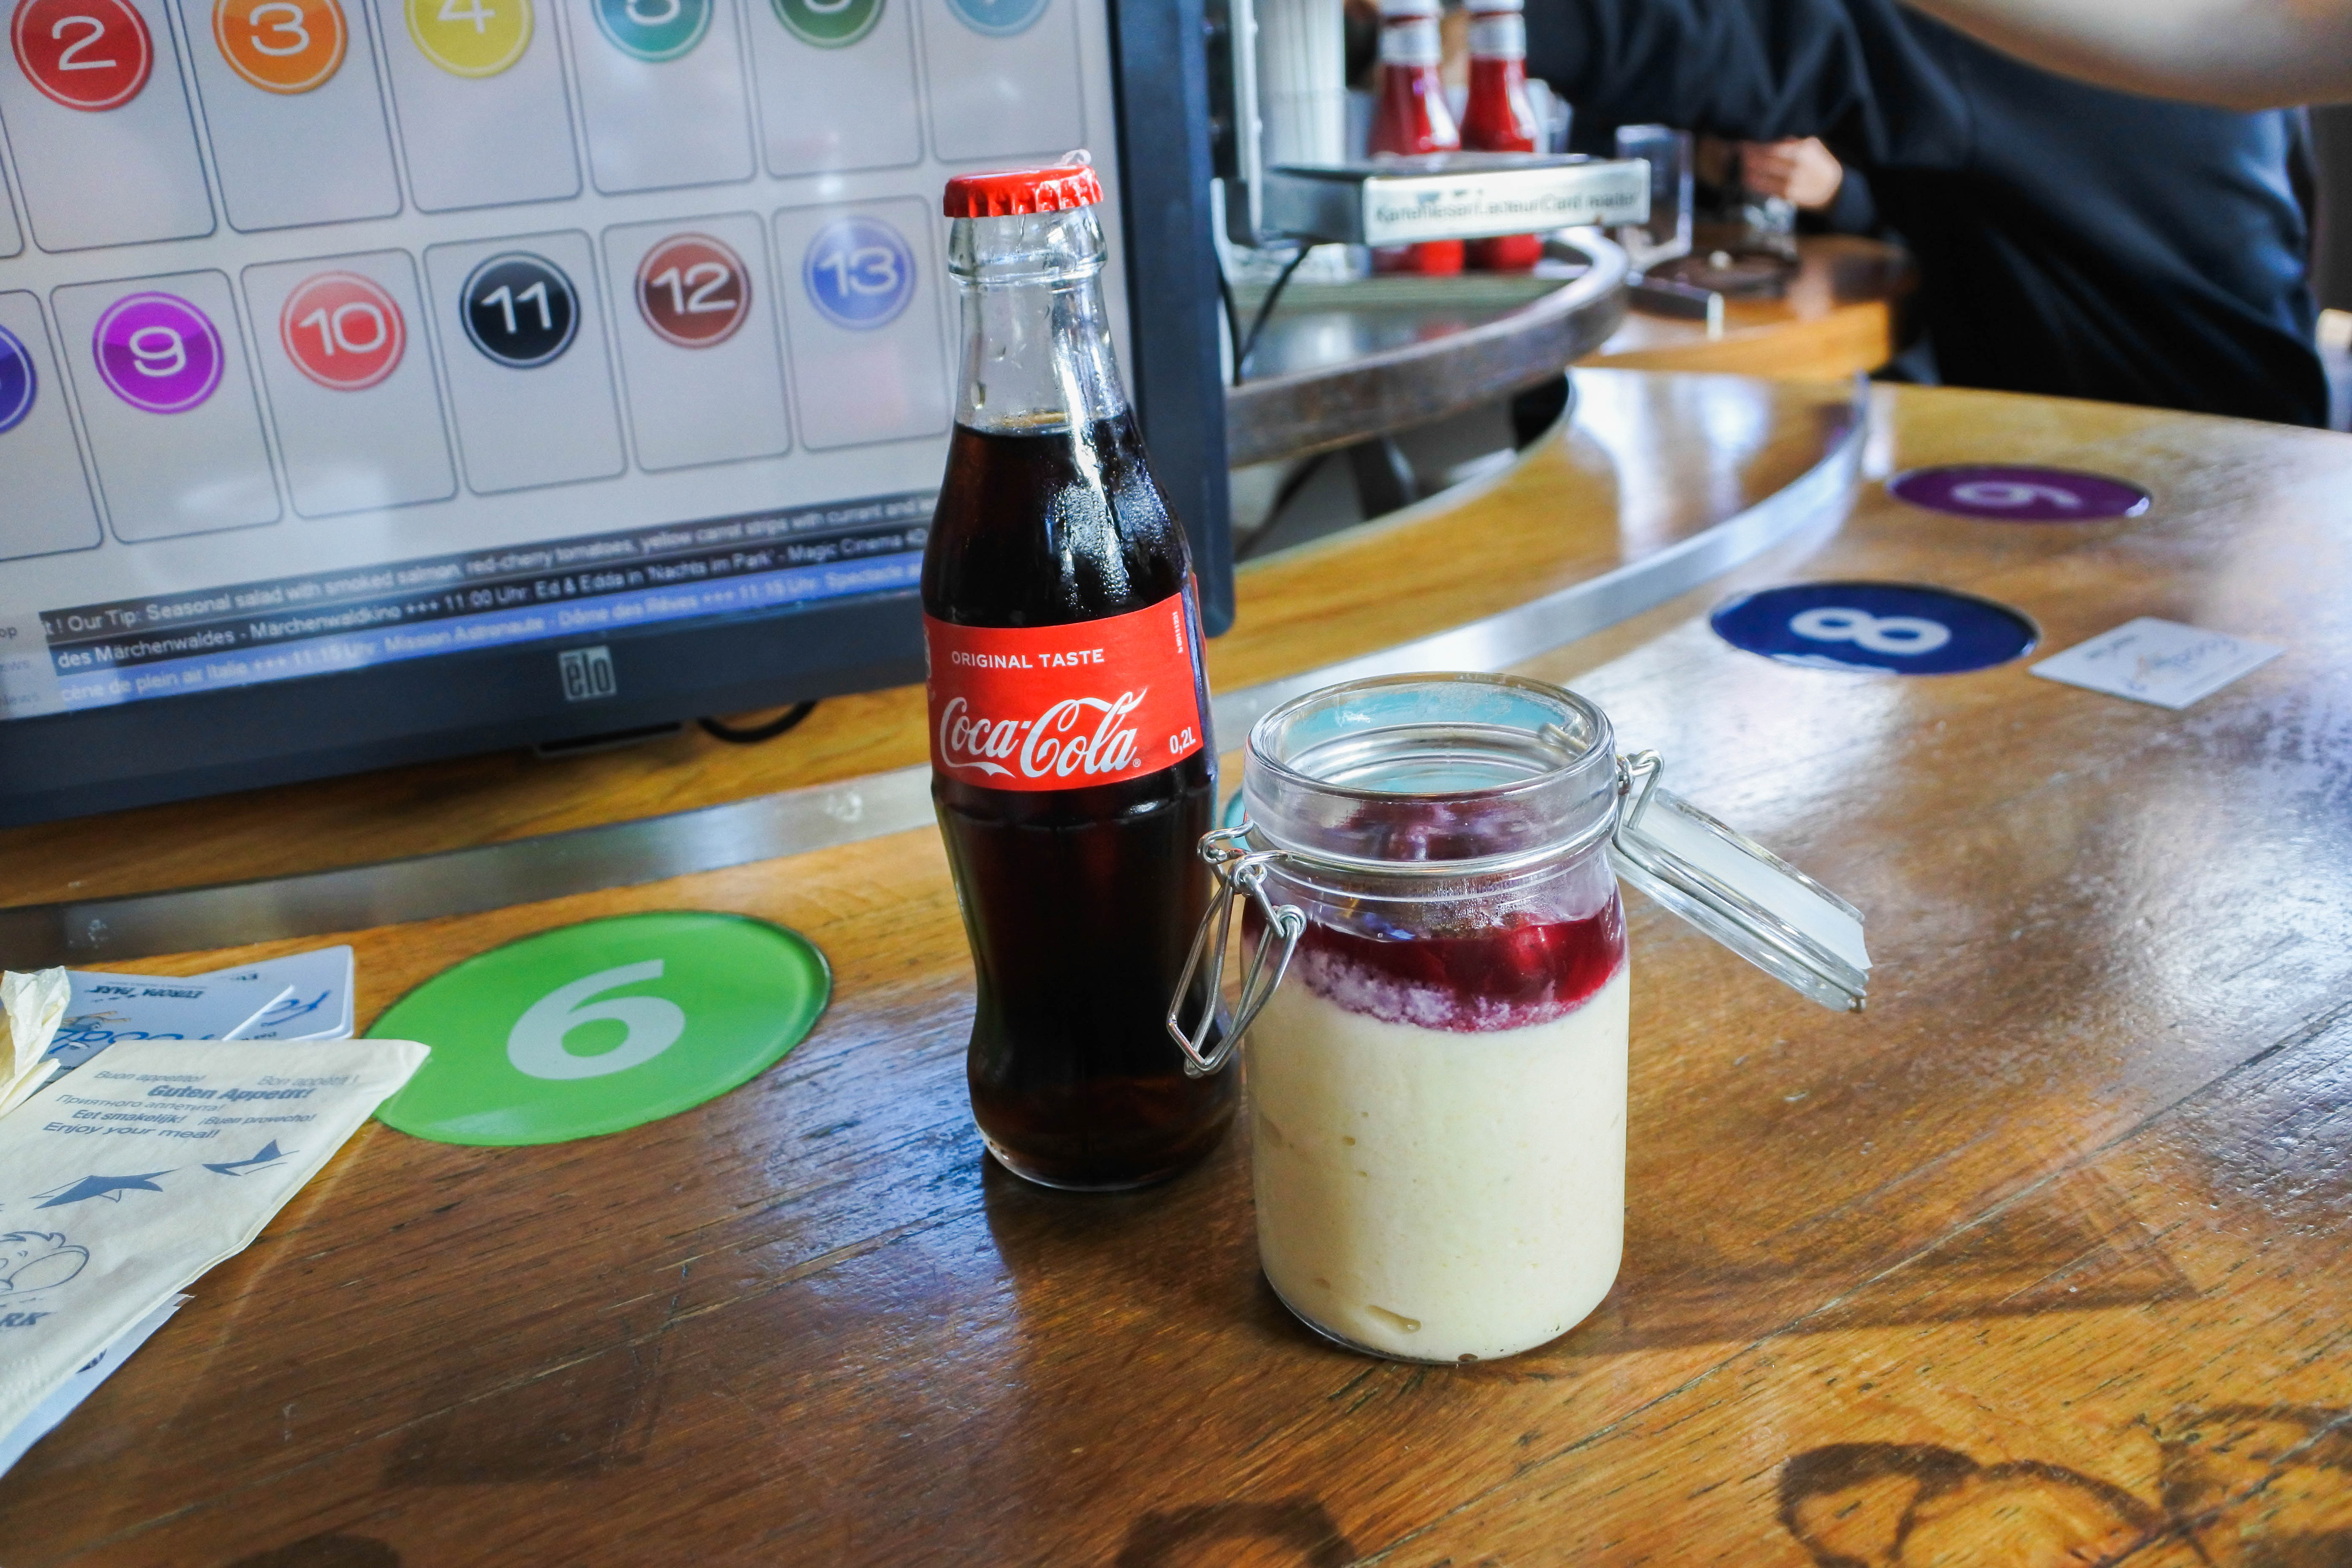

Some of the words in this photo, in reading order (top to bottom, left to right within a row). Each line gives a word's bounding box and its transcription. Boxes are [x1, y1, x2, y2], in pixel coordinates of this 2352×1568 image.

[248, 3, 310, 57] 3
[438, 0, 495, 34] 4
[52, 15, 117, 71] 2
[652, 262, 736, 315] 12
[819, 246, 899, 300] 13
[298, 302, 387, 356] 10
[480, 283, 552, 334] 11
[129, 327, 186, 376] 9
[55, 646, 93, 667] des
[93, 626, 236, 662] Märchenwaldes
[249, 602, 402, 639] Märchenwaldkino
[534, 579, 560, 599] Ed
[66, 612, 103, 632] Our
[104, 607, 144, 630] Tip:
[145, 594, 232, 621] Seasonal
[234, 587, 283, 608] salad
[286, 581, 321, 601] with
[324, 571, 394, 595] smoked
[1790, 607, 1952, 655] 8
[107, 675, 131, 694] de
[134, 668, 179, 693] plein
[952, 651, 1032, 668] ORIGINAL
[1039, 648, 1104, 667] TASTE
[940, 687, 1147, 778] Coca-Cola
[1169, 727, 1195, 754] 0,2L
[507, 959, 685, 1080] 6
[95, 1071, 135, 1079] Buon
[136, 1074, 206, 1083] appetito!
[148, 1085, 218, 1098] Guten
[217, 1088, 316, 1101] Appetit!
[257, 1076, 290, 1085] Bon
[55, 1094, 143, 1108] Приятного
[144, 1102, 226, 1112] аппетита!
[71, 1109, 102, 1119] Eet
[101, 1113, 188, 1124] smakelijk!
[242, 1114, 317, 1124] provecho!
[43, 1122, 104, 1135] Enjoy
[102, 1127, 155, 1135] your
[158, 1129, 221, 1138] meal!
